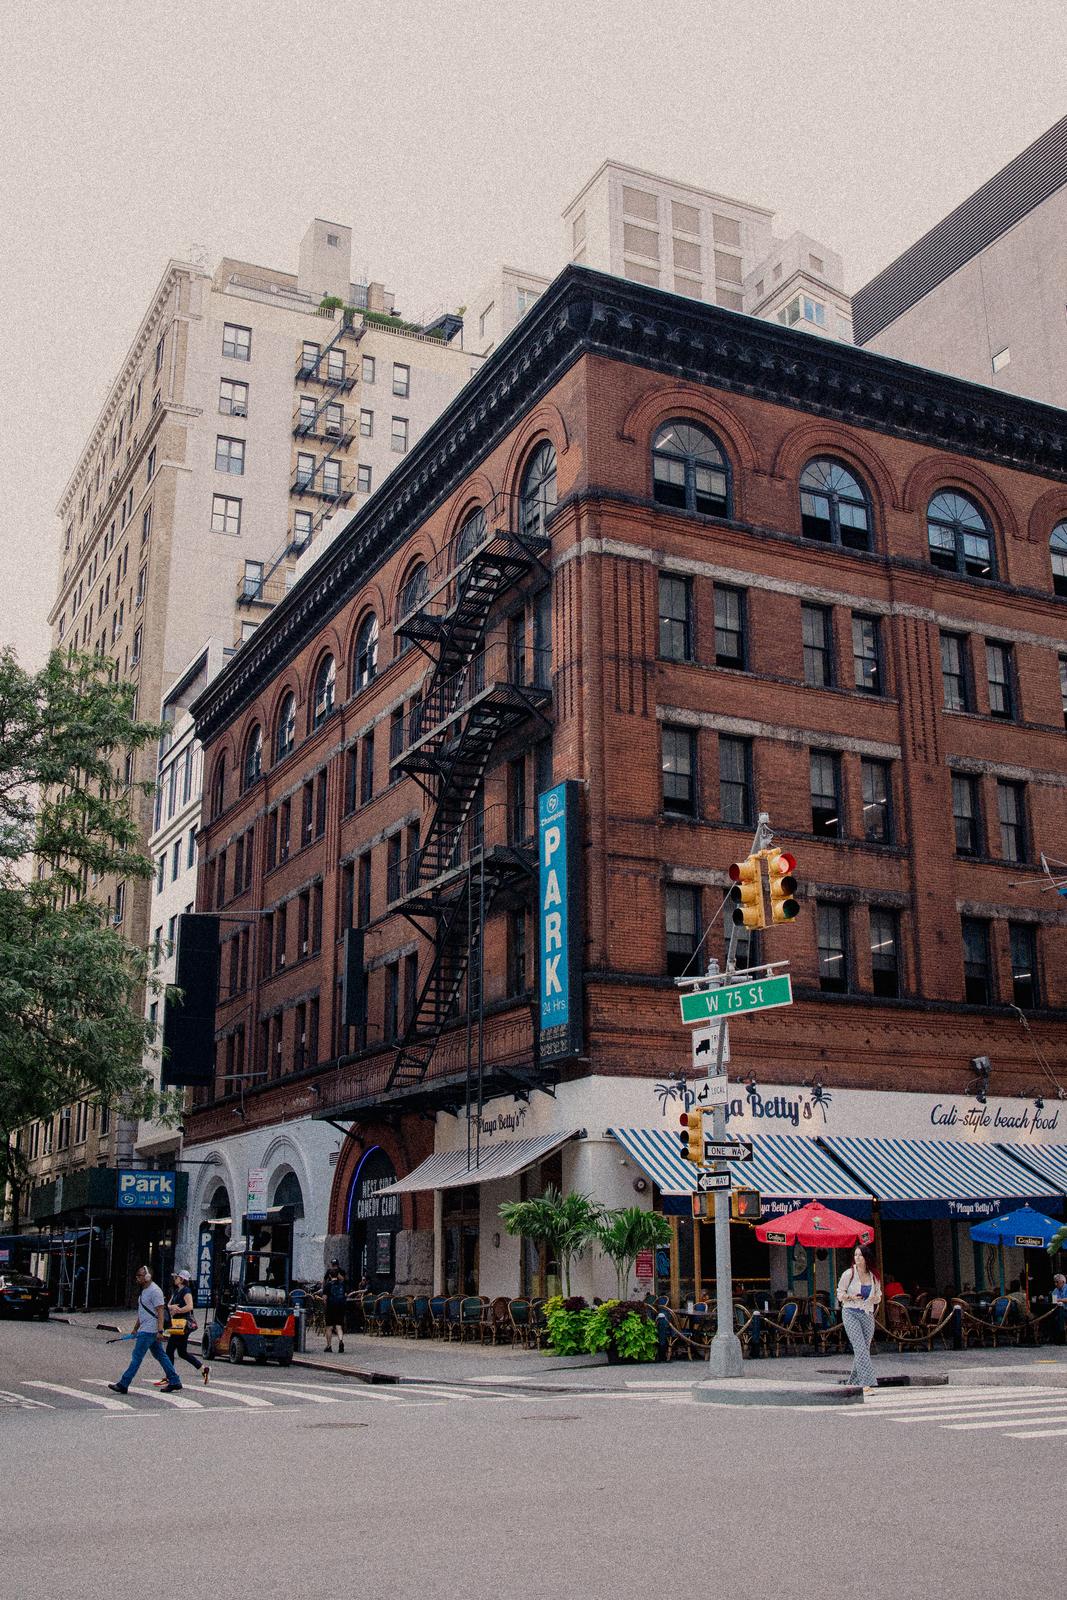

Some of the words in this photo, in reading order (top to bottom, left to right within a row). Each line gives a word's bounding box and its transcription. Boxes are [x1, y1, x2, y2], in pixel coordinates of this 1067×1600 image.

[544, 826, 562, 997] PARK
[543, 1001, 551, 1016] 24
[706, 995, 719, 1013] W
[725, 991, 742, 1008] 75
[749, 986, 764, 1005] St
[747, 1093, 812, 1127] Betty's
[930, 1104, 992, 1133] Cali-style
[994, 1106, 1029, 1129] beach
[1029, 1108, 1060, 1135] food
[498, 1111, 520, 1133] Betty's
[711, 1146, 726, 1155] ONE
[731, 1147, 746, 1156] WAY
[120, 1174, 173, 1193] Park
[701, 1178, 712, 1187] ONE
[715, 1176, 727, 1185] WAY
[956, 1202, 974, 1215] Playa
[975, 1202, 994, 1214] Betty's
[199, 1232, 212, 1289] PARK
